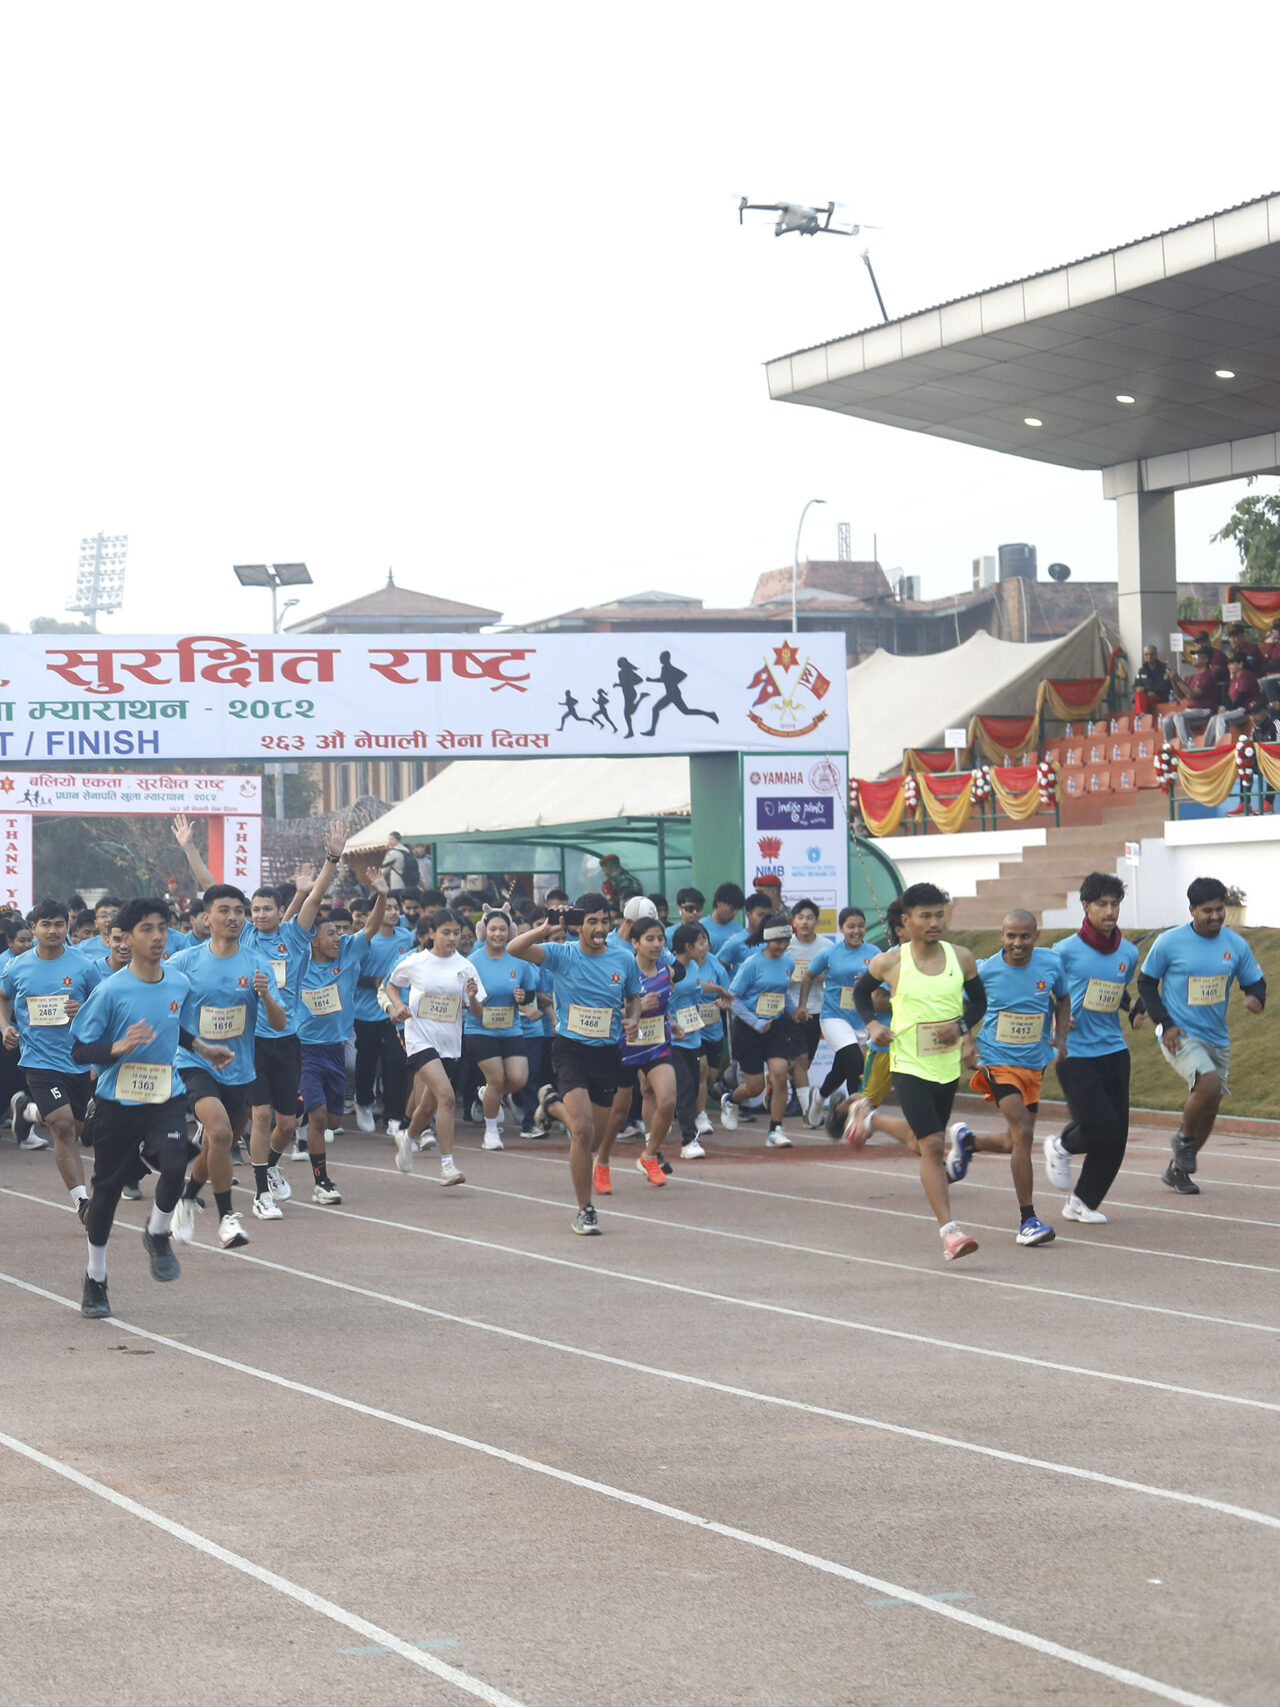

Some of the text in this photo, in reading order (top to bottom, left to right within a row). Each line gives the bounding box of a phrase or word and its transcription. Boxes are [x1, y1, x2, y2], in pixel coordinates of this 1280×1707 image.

[45, 635, 341, 695] सुरक्षित
[368, 647, 538, 693] राष्ट्र
[27, 699, 190, 722] म्याराथन
[228, 699, 316, 720] २०८२
[46, 729, 160, 756] FINISH
[260, 734, 306, 751] २६३
[353, 729, 428, 751] नेपाली
[435, 728, 484, 750] सेना
[490, 728, 551, 750] दिवस
[29, 774, 77, 788] बलियो
[82, 777, 123, 789] एकता
[136, 775, 190, 791] सुरक्षित
[762, 770, 804, 785] YAMAHA
[5, 818, 19, 875] THANK
[235, 821, 248, 877] THANK
[755, 865, 785, 877] NIMB
[313, 999, 330, 1008] 1614
[430, 1005, 448, 1013] 2420
[39, 1008, 57, 1016] 2487
[213, 1021, 233, 1030] 1616
[580, 1019, 599, 1028] 1468
[1010, 1026, 1031, 1034] 1413
[132, 1080, 155, 1091] 1363
[50, 1086, 63, 1101] 15
